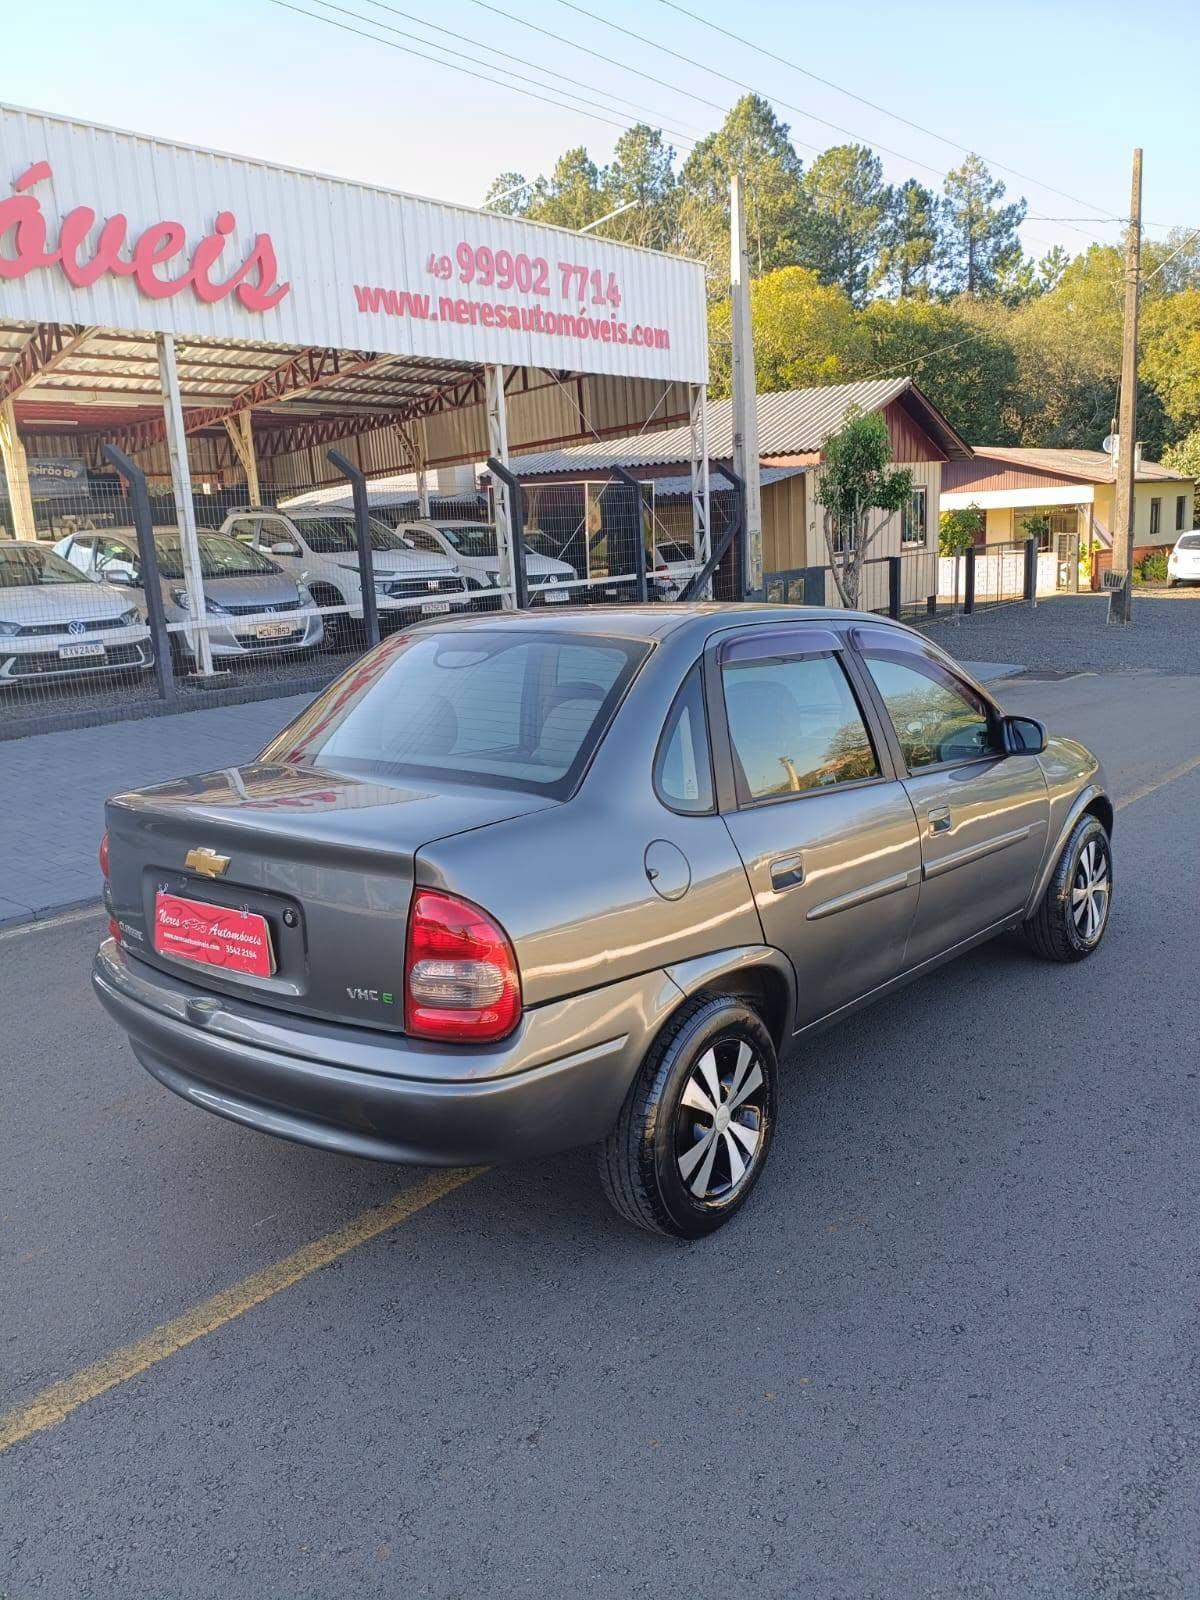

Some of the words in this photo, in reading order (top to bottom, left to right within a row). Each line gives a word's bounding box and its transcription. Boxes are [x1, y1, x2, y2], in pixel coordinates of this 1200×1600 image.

[427, 253, 453, 280] 49
[456, 241, 551, 296] 99902
[558, 262, 622, 307] 7714
[353, 284, 671, 349] www.neresautomóveis.com
